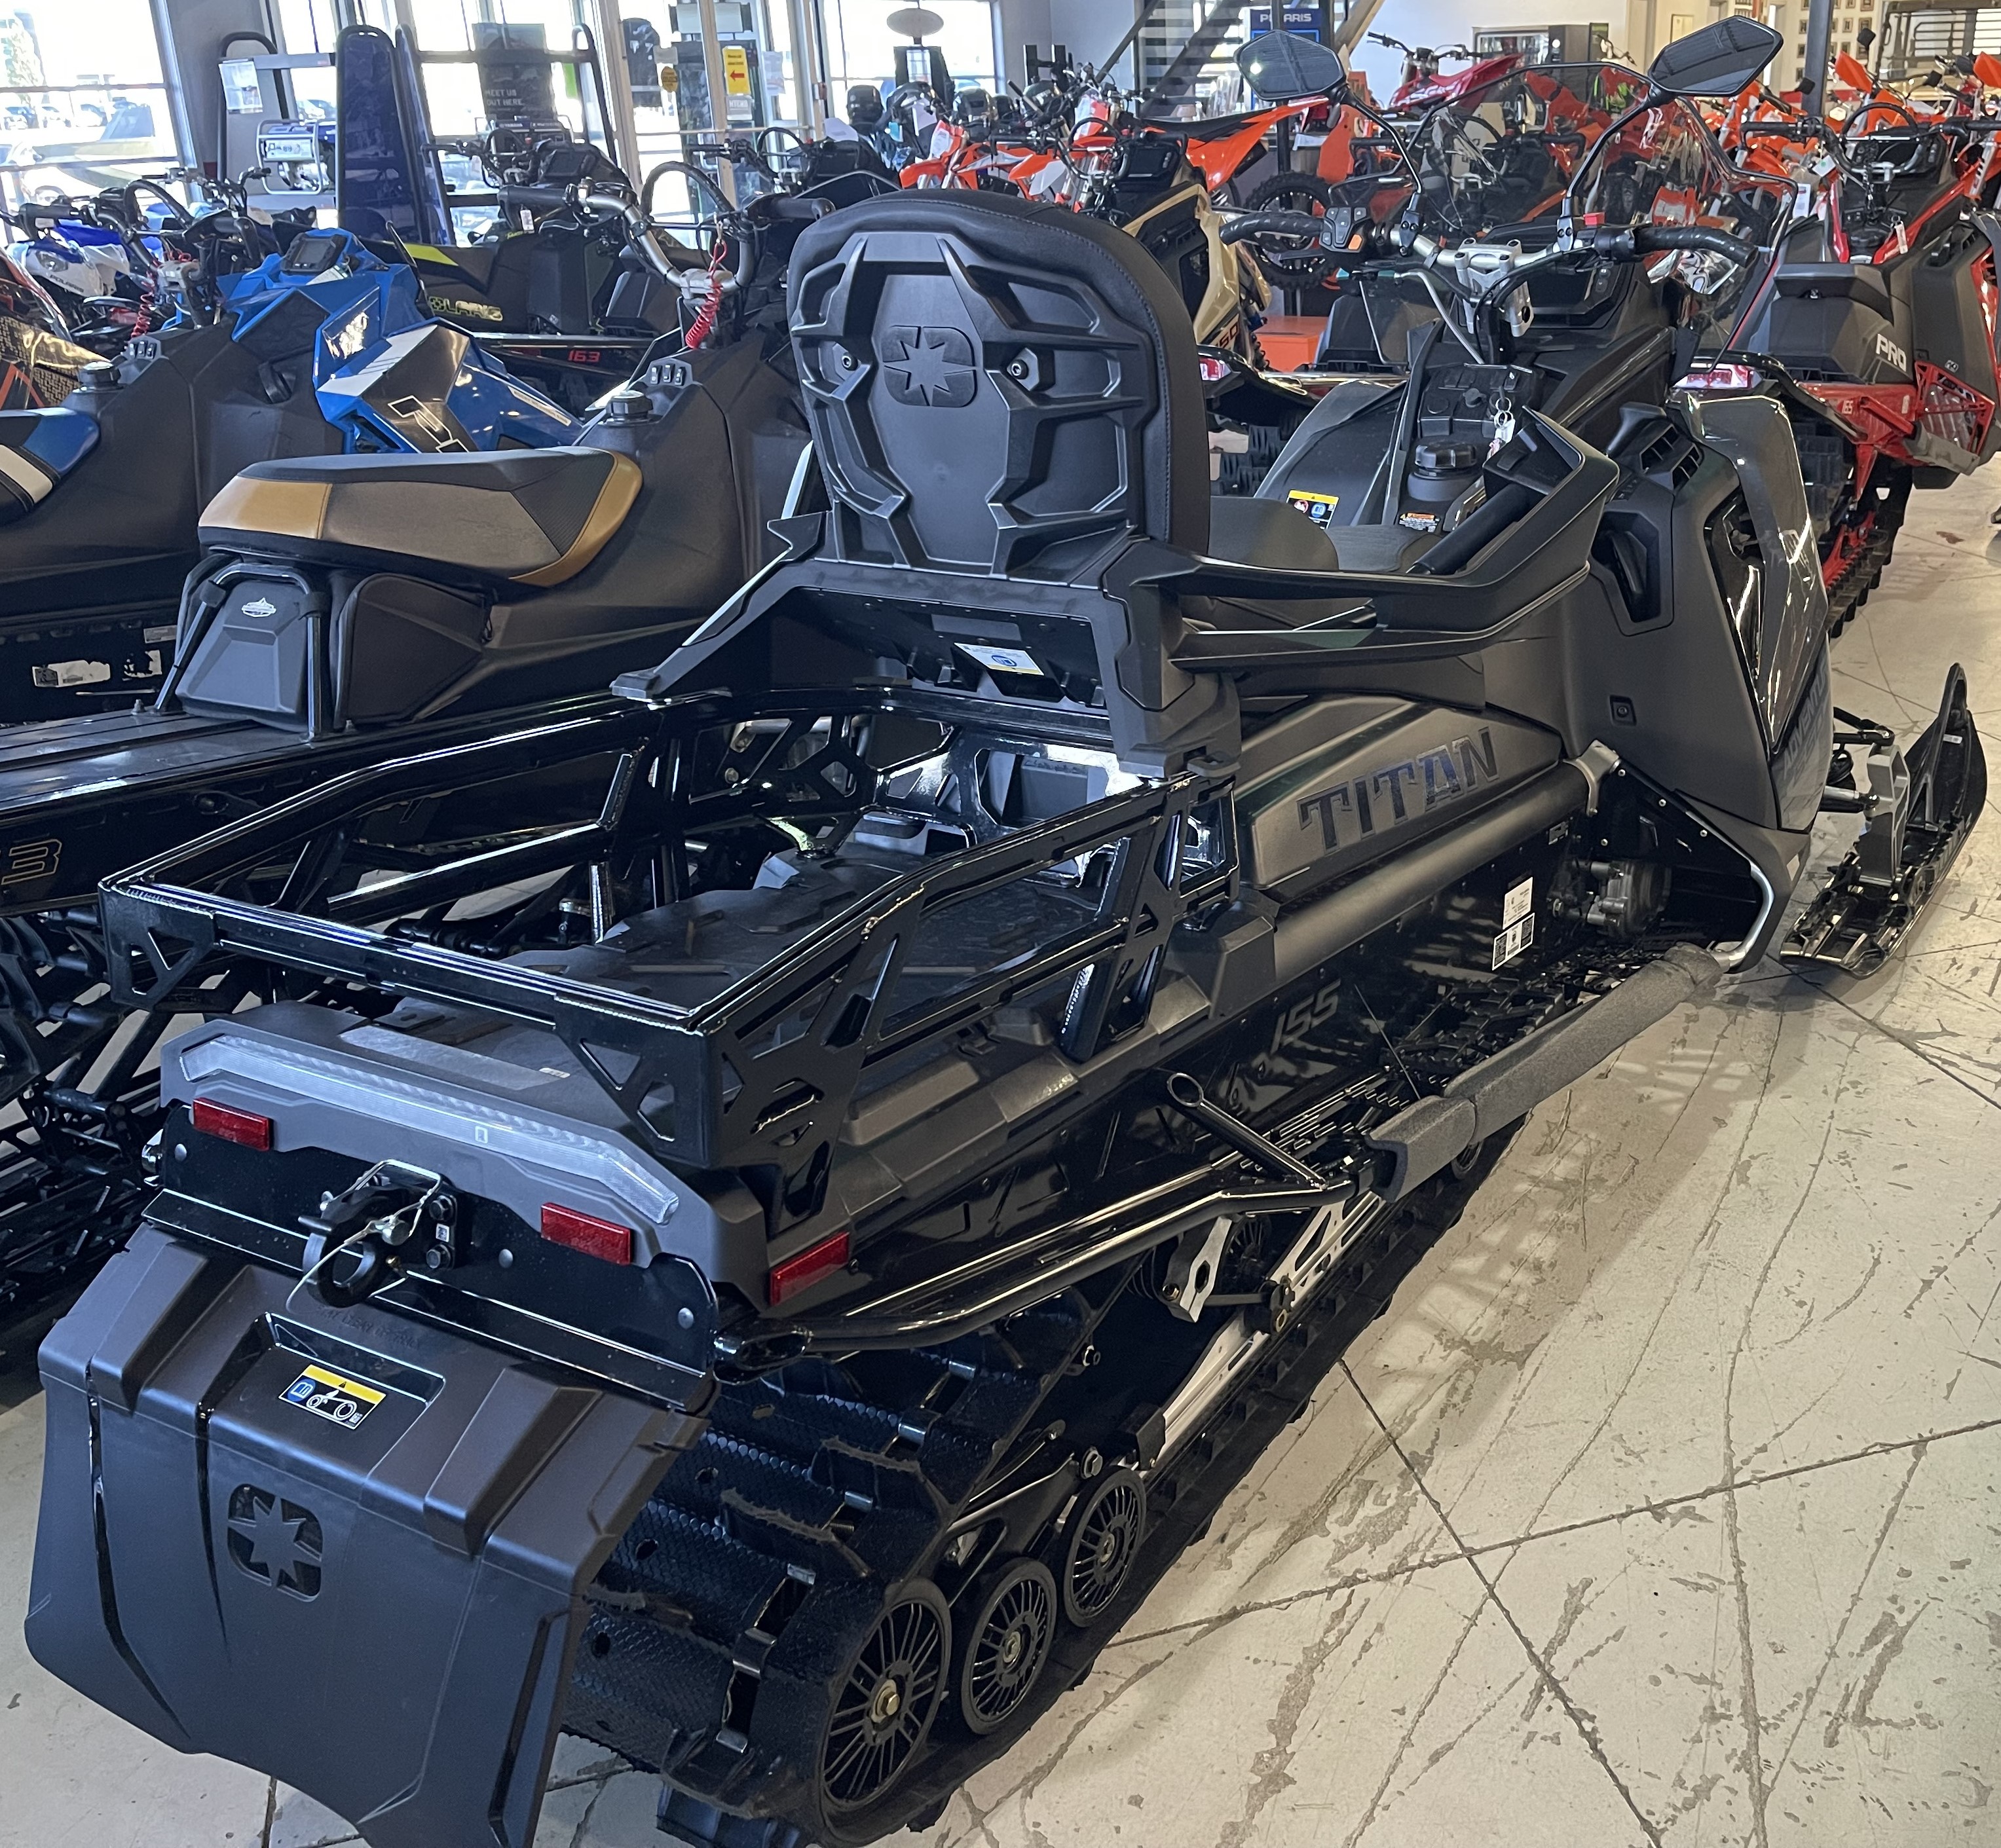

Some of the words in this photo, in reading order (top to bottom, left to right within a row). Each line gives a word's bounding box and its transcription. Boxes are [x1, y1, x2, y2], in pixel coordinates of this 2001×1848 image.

[1260, 13, 1312, 22] PARIS
[429, 296, 504, 322] OLARIS
[1215, 321, 1239, 349] 50
[1876, 333, 1907, 372] PRO
[567, 350, 601, 363] 163
[1782, 654, 1829, 782] ADVENTU
[1296, 726, 1500, 857] TITAN
[0, 839, 62, 885] 3
[1270, 979, 1341, 1056] 155
